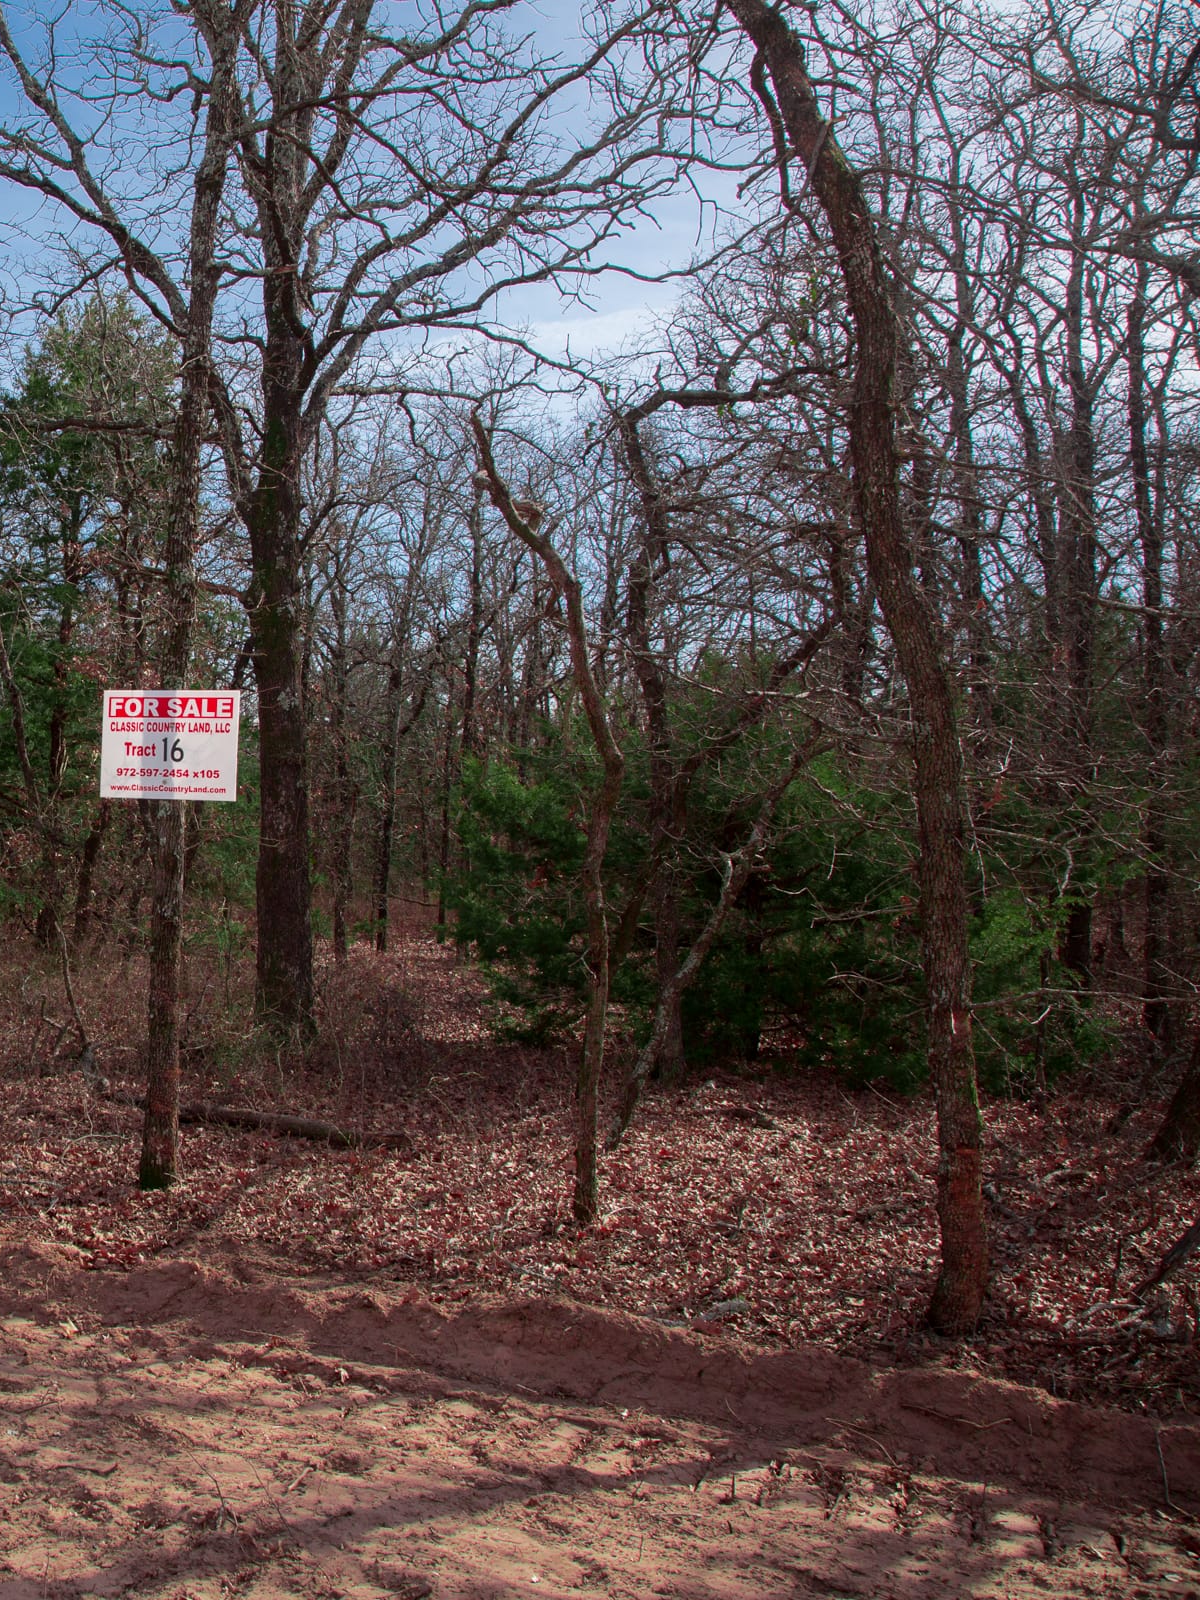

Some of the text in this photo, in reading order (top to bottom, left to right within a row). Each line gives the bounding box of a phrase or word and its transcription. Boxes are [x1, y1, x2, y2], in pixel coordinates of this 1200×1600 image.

[110, 698, 232, 717] FOR SALE
[110, 722, 231, 735] CLASSIC COUNTRY LAND, LLC
[124, 737, 184, 762] Tract 16
[116, 768, 220, 778] 972-597-2454 x105
[110, 784, 226, 794] www.ClassicCountryLand.com
